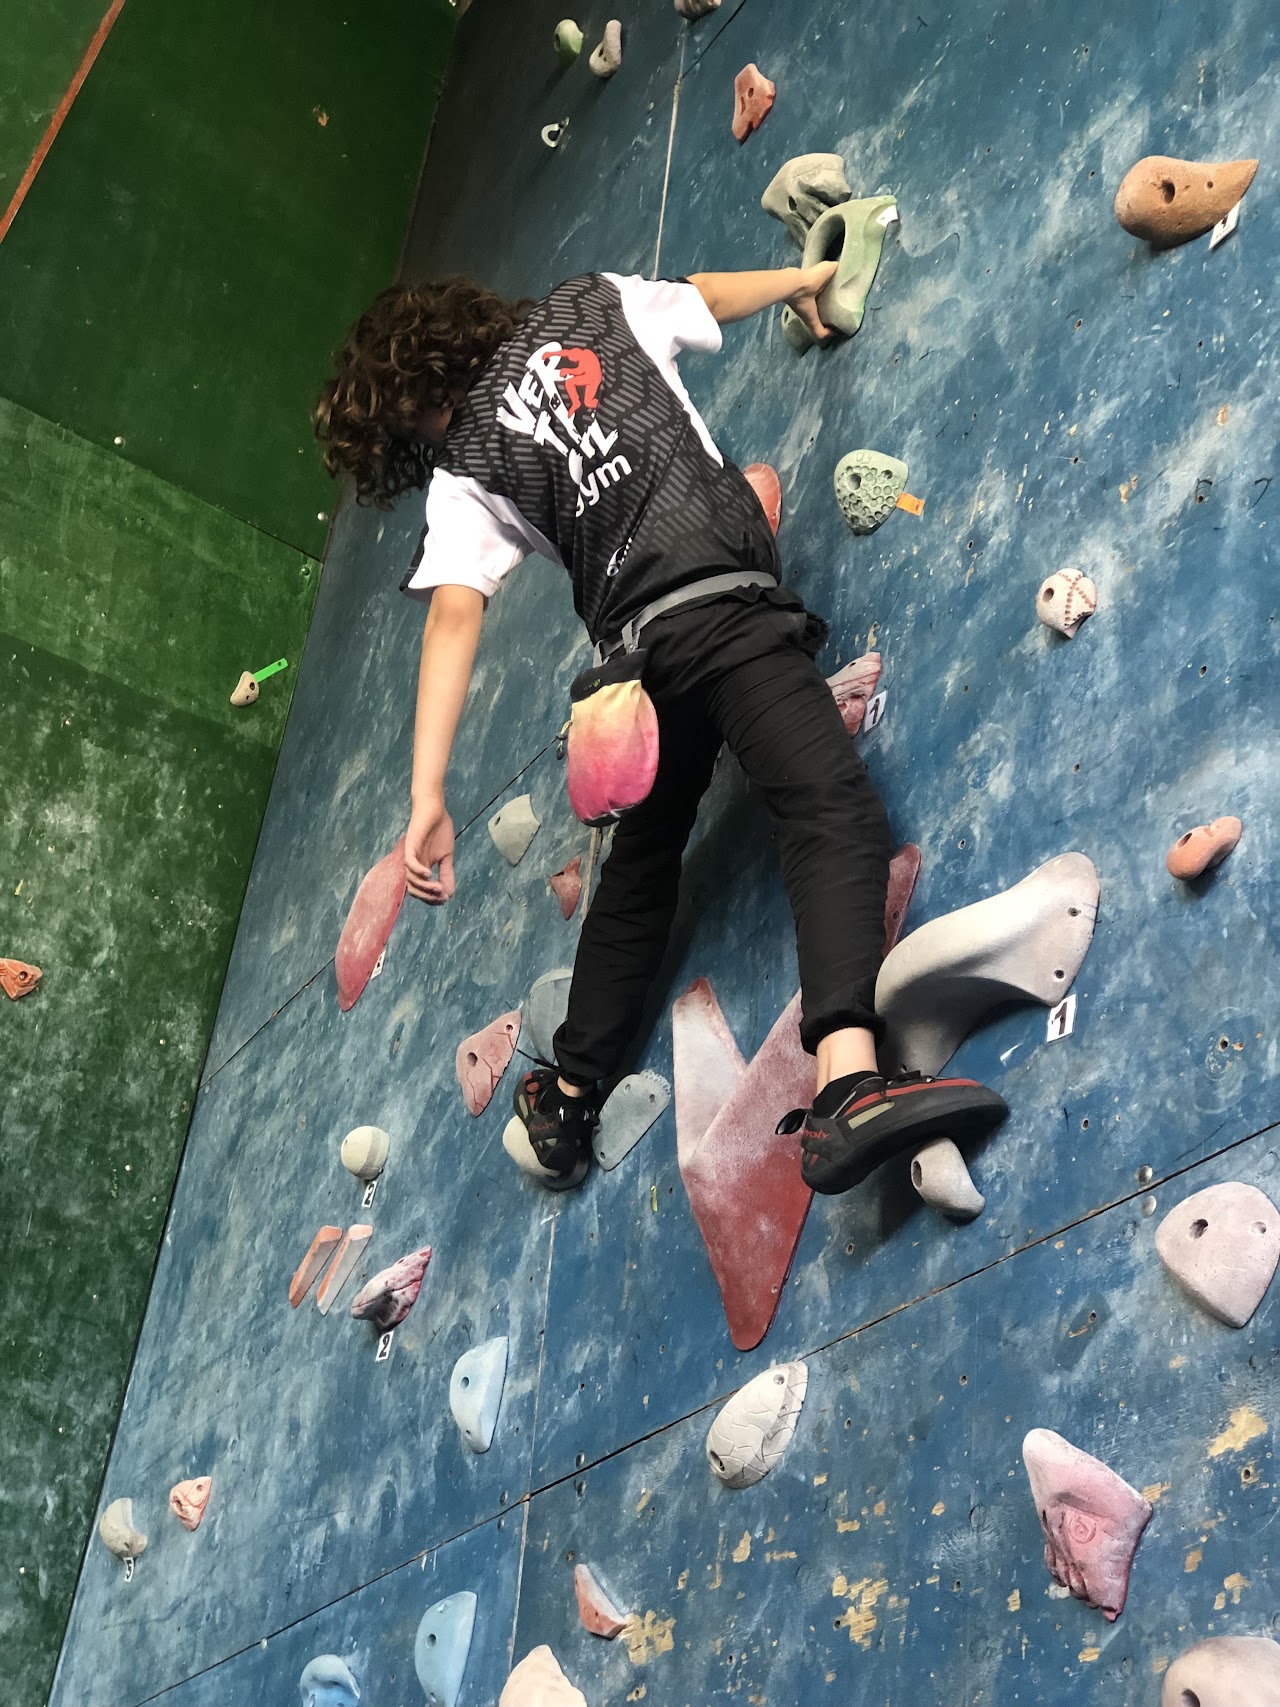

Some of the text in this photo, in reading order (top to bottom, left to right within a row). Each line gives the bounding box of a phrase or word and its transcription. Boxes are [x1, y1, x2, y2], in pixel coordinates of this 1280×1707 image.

[869, 697, 880, 726] 1
[1054, 1001, 1068, 1036] 1
[364, 1183, 374, 1205] 2
[379, 1333, 391, 1358] 2
